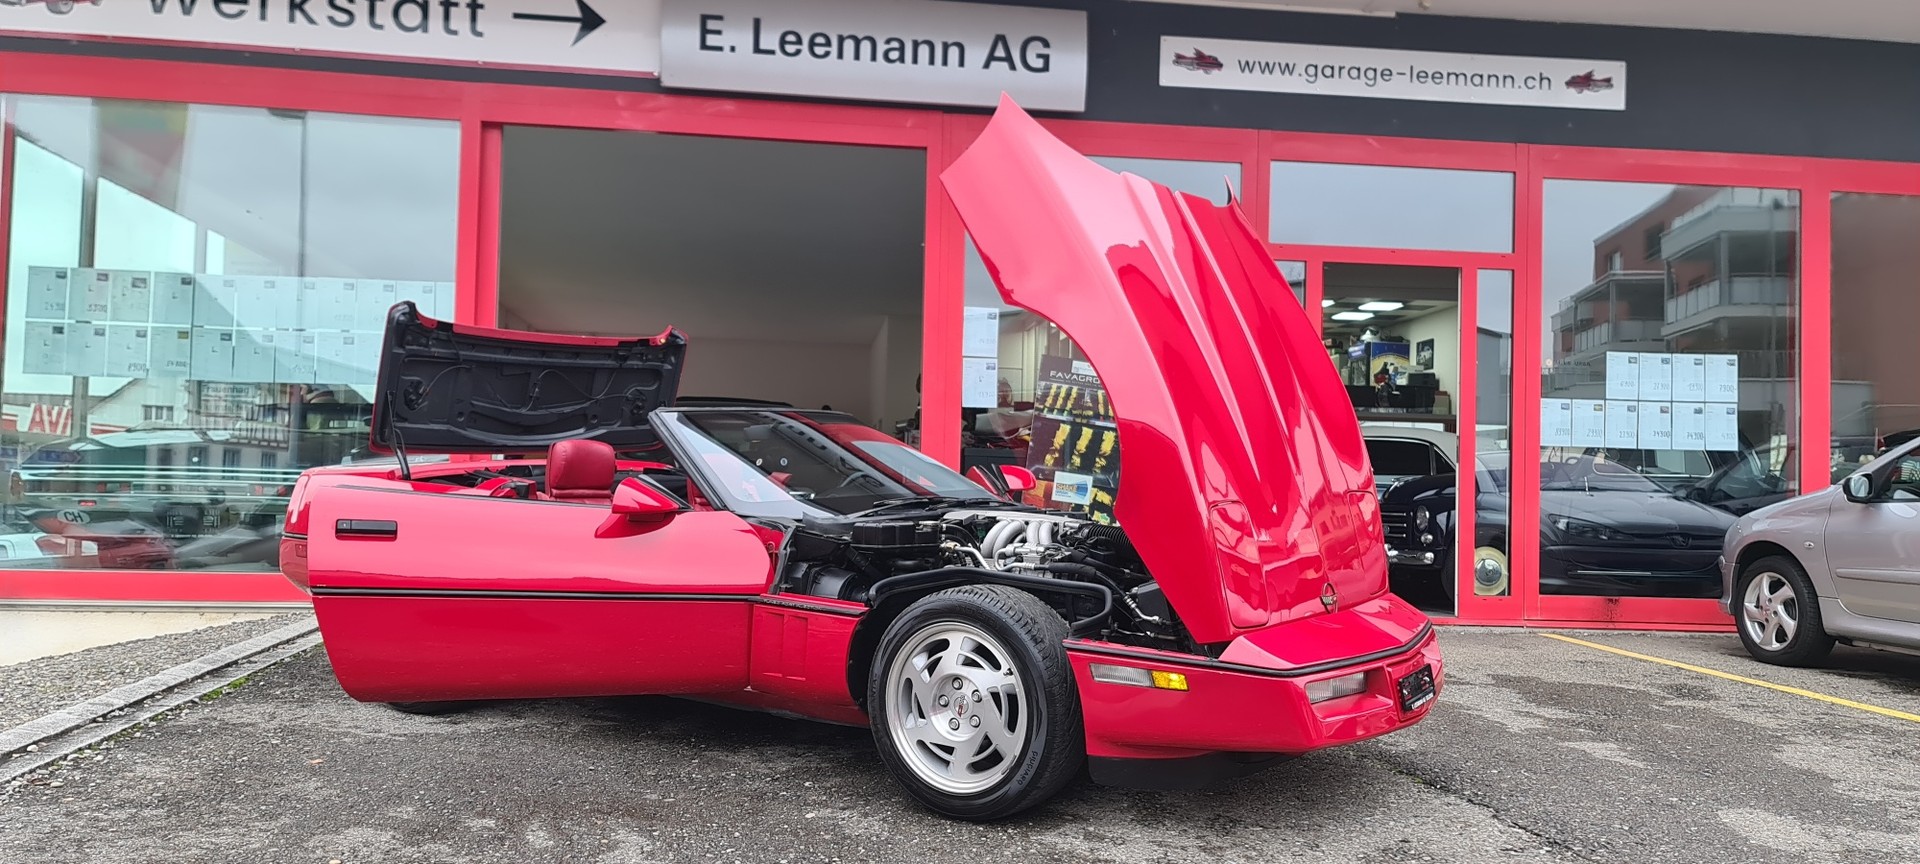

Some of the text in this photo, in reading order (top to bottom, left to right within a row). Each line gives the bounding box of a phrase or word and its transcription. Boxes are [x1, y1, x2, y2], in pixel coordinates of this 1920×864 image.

[700, 14, 1051, 73] E. Leemann AG
[1237, 57, 1552, 91] www.garage-leemann.ch
[63, 511, 84, 523] CH
